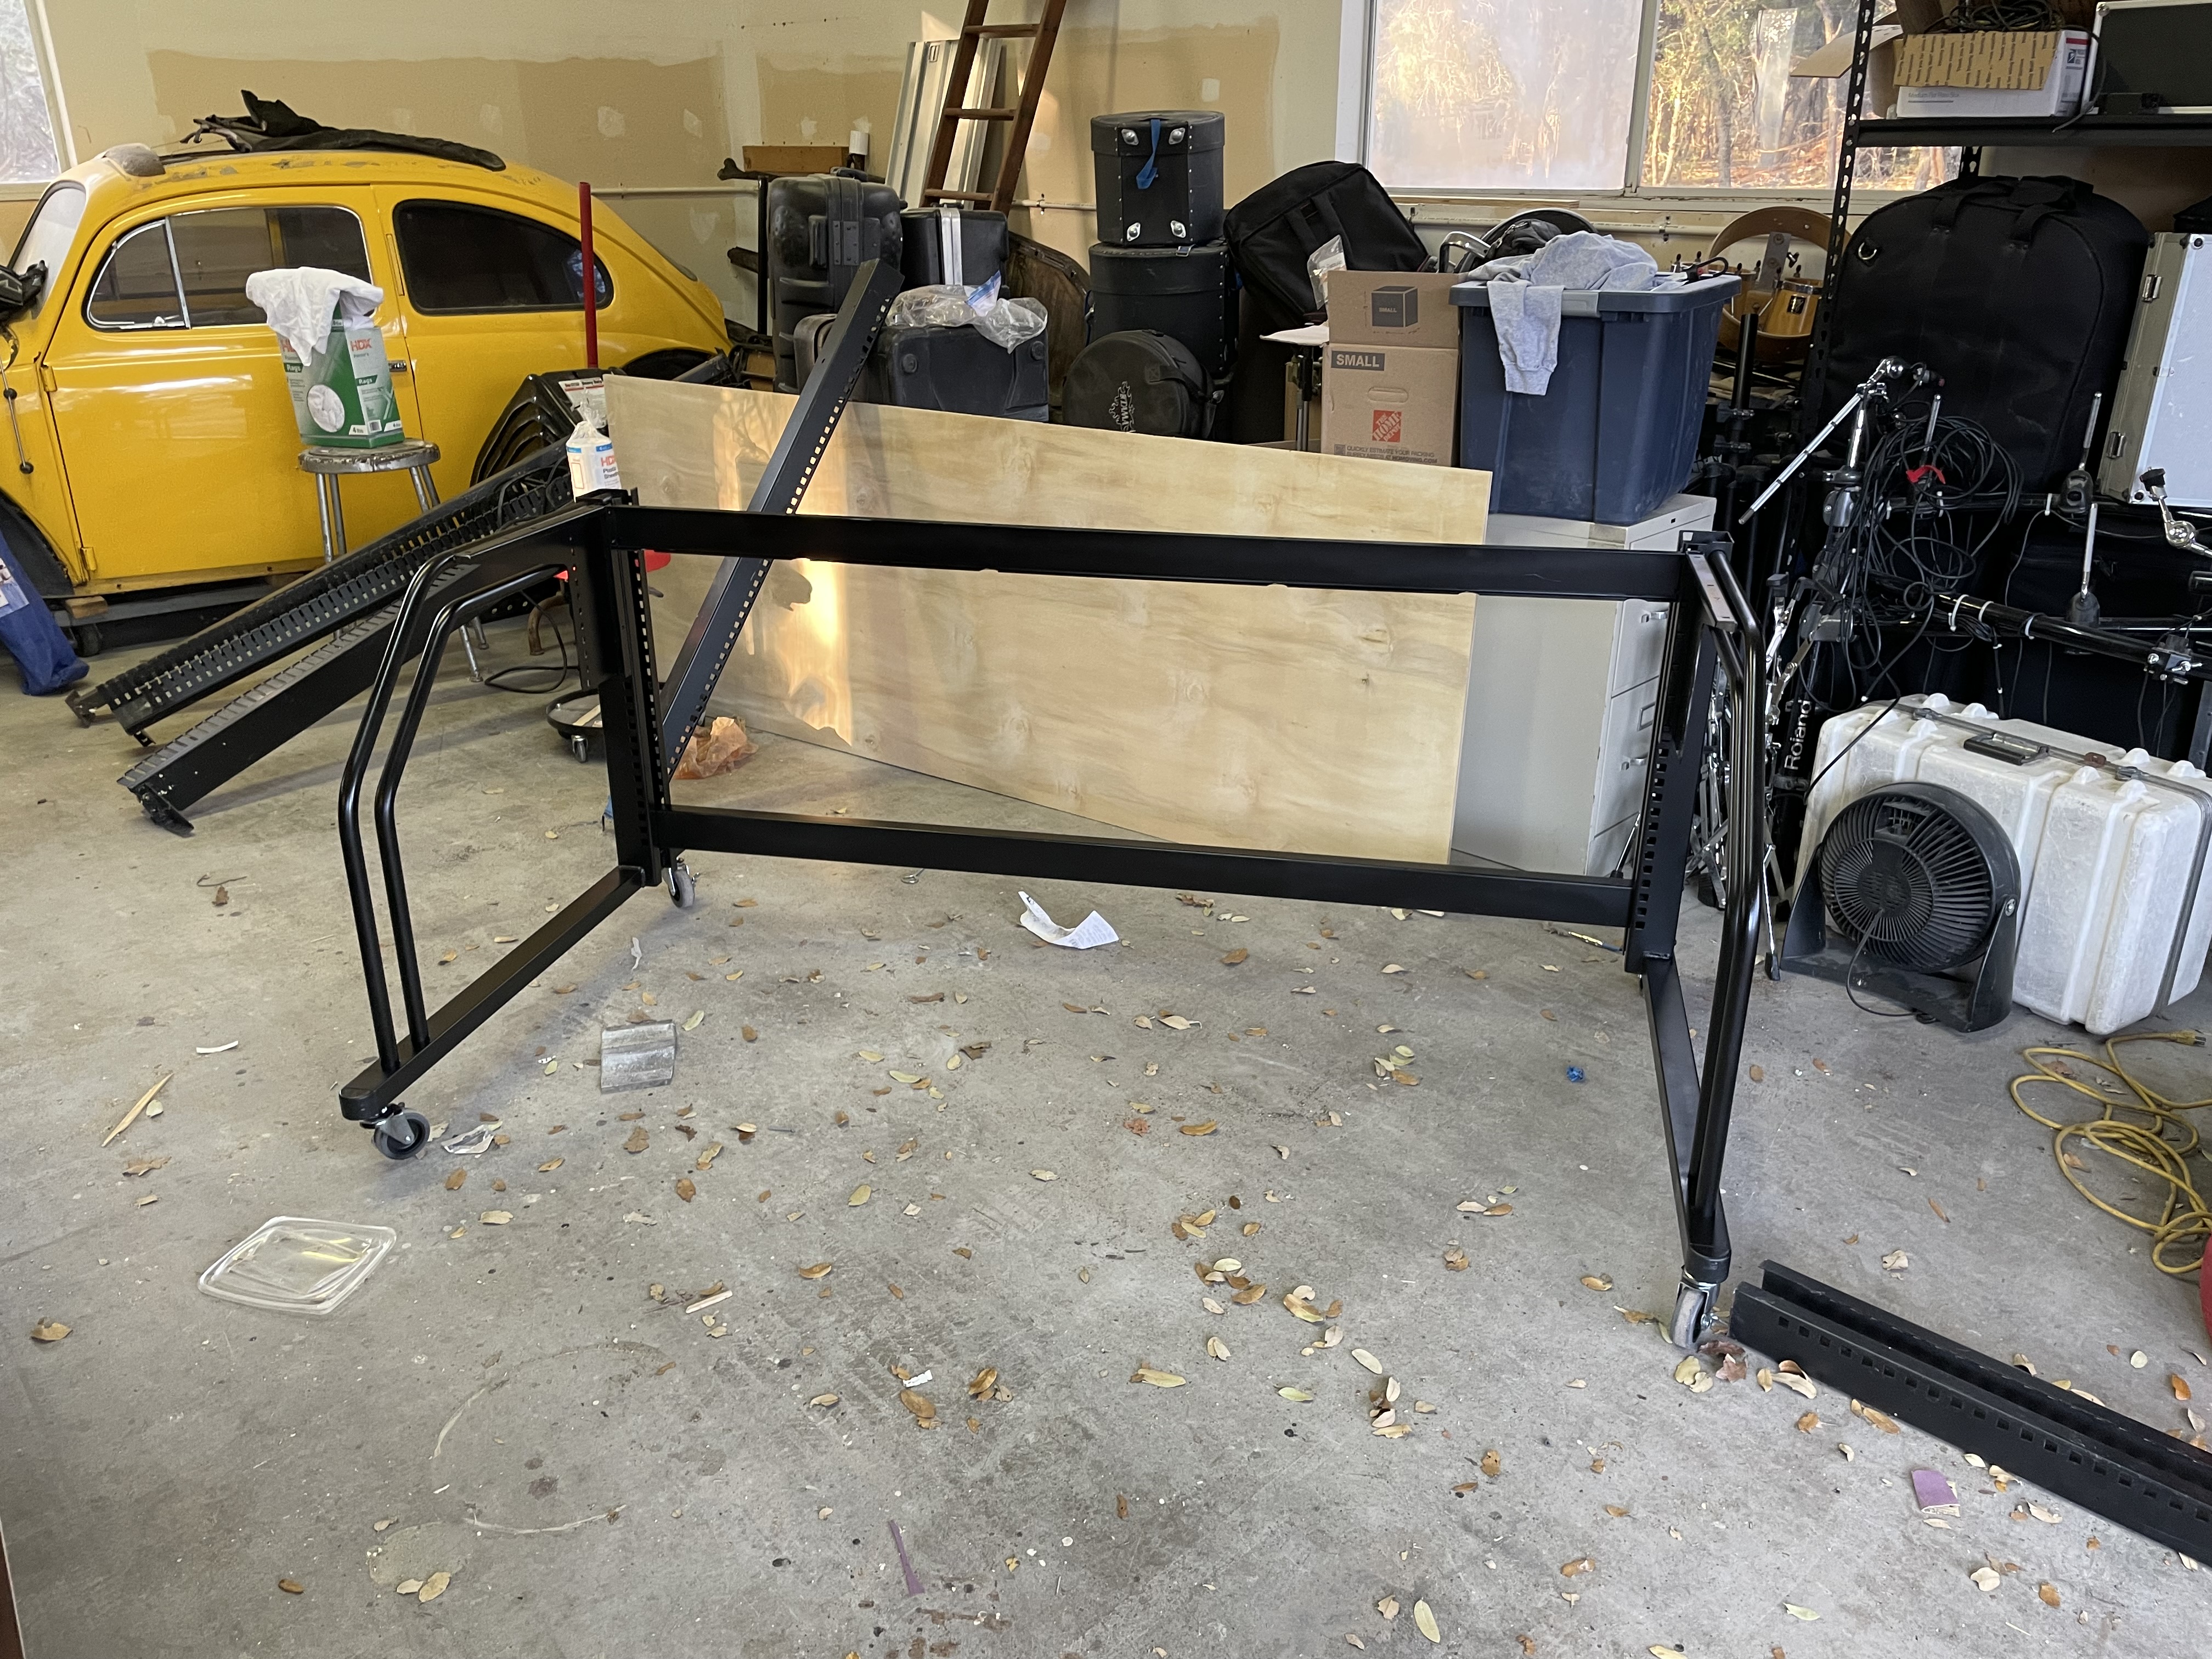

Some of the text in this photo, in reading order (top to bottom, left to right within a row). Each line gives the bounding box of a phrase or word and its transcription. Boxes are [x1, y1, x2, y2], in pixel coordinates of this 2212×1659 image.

[350, 338, 372, 352] HDX
[1336, 354, 1380, 367] SMALL
[286, 364, 301, 373] Rags
[1373, 411, 1401, 441] HOME
[601, 455, 616, 467] HD
[1784, 700, 1812, 770] Roland
